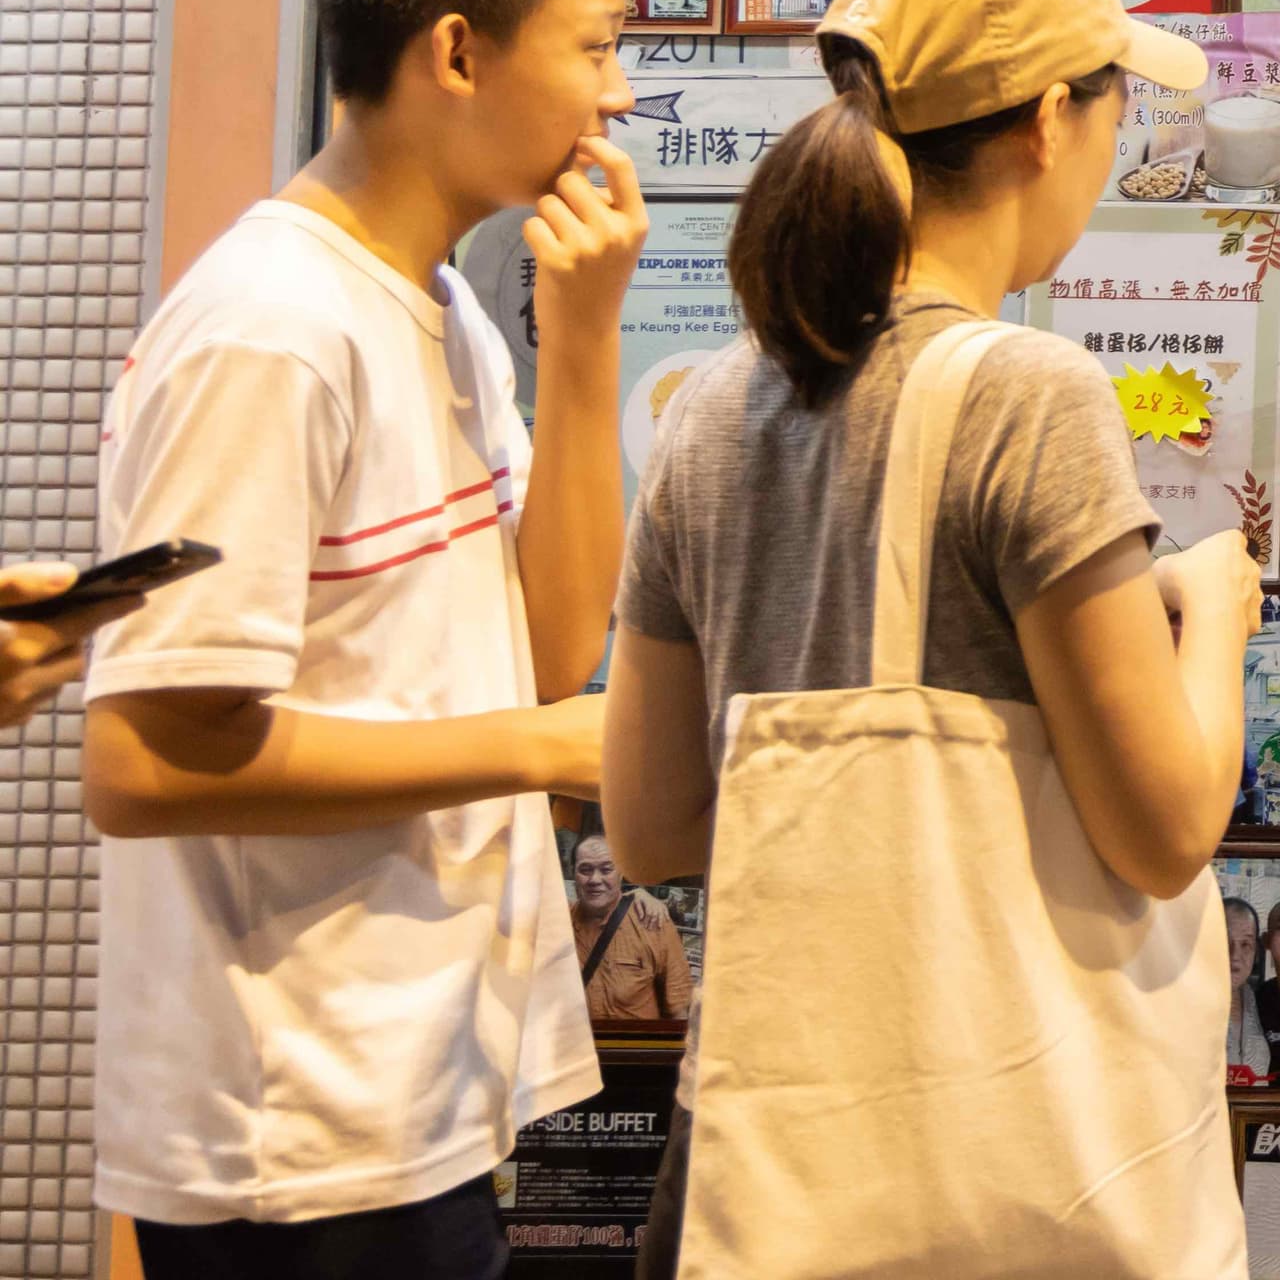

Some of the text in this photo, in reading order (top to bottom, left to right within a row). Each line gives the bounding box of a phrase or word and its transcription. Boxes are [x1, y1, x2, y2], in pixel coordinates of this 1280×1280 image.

[638, 259, 688, 269] EXPLORE
[640, 322, 738, 334] Keung Kee Egg
[1084, 332, 1225, 355] 雞蛋仔/格仔餅
[589, 1113, 657, 1132] BUFFET
